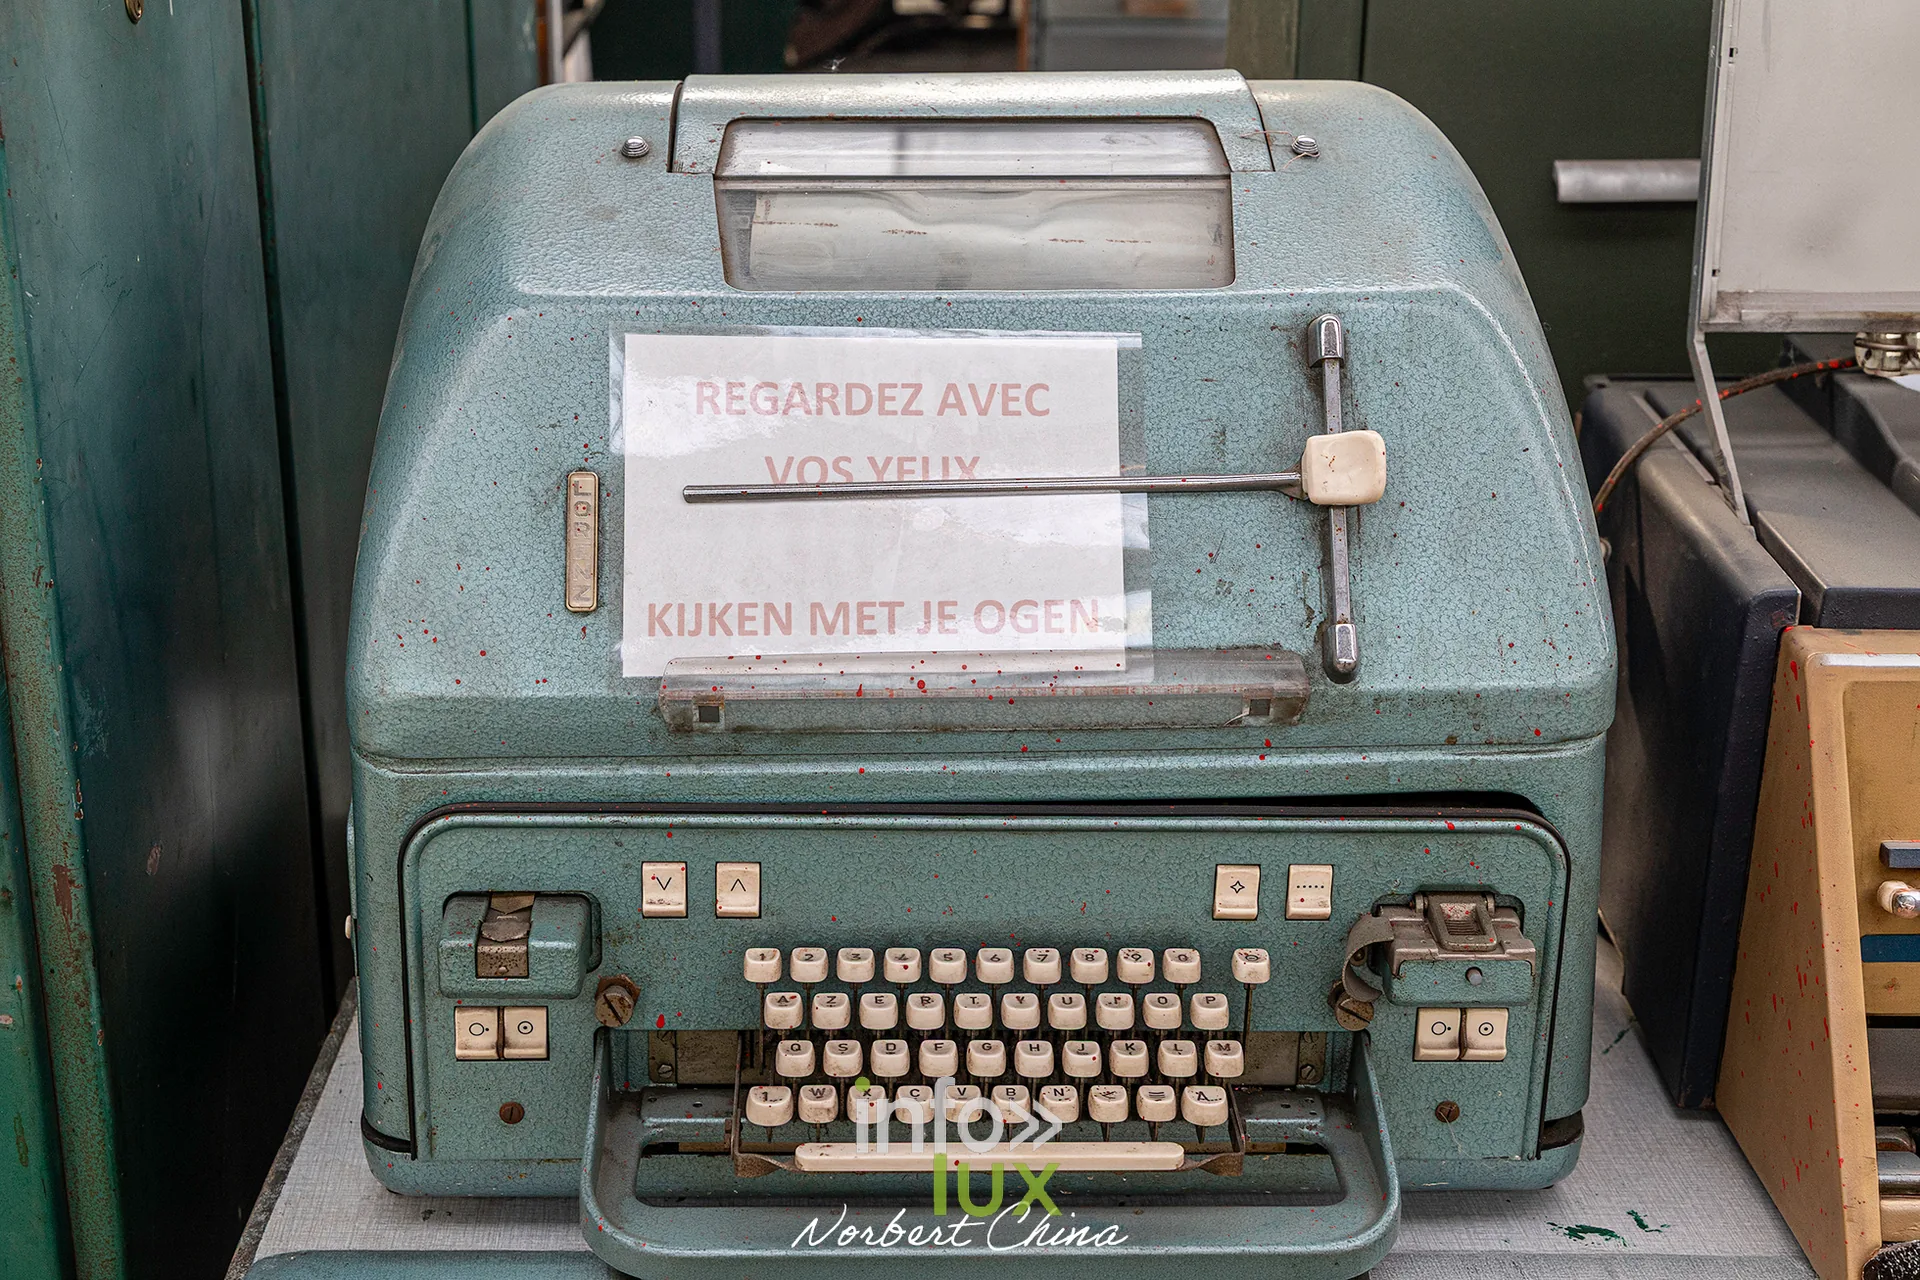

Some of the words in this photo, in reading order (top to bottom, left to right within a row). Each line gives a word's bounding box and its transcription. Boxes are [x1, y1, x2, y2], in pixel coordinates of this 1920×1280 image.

[695, 381, 923, 417] REGARDEZ
[937, 382, 1051, 417] AVEC
[764, 455, 854, 485] VOS
[647, 601, 792, 638] KIJKEN
[810, 600, 904, 637] MET
[916, 600, 958, 636] JE
[973, 599, 1099, 635] OGEN
